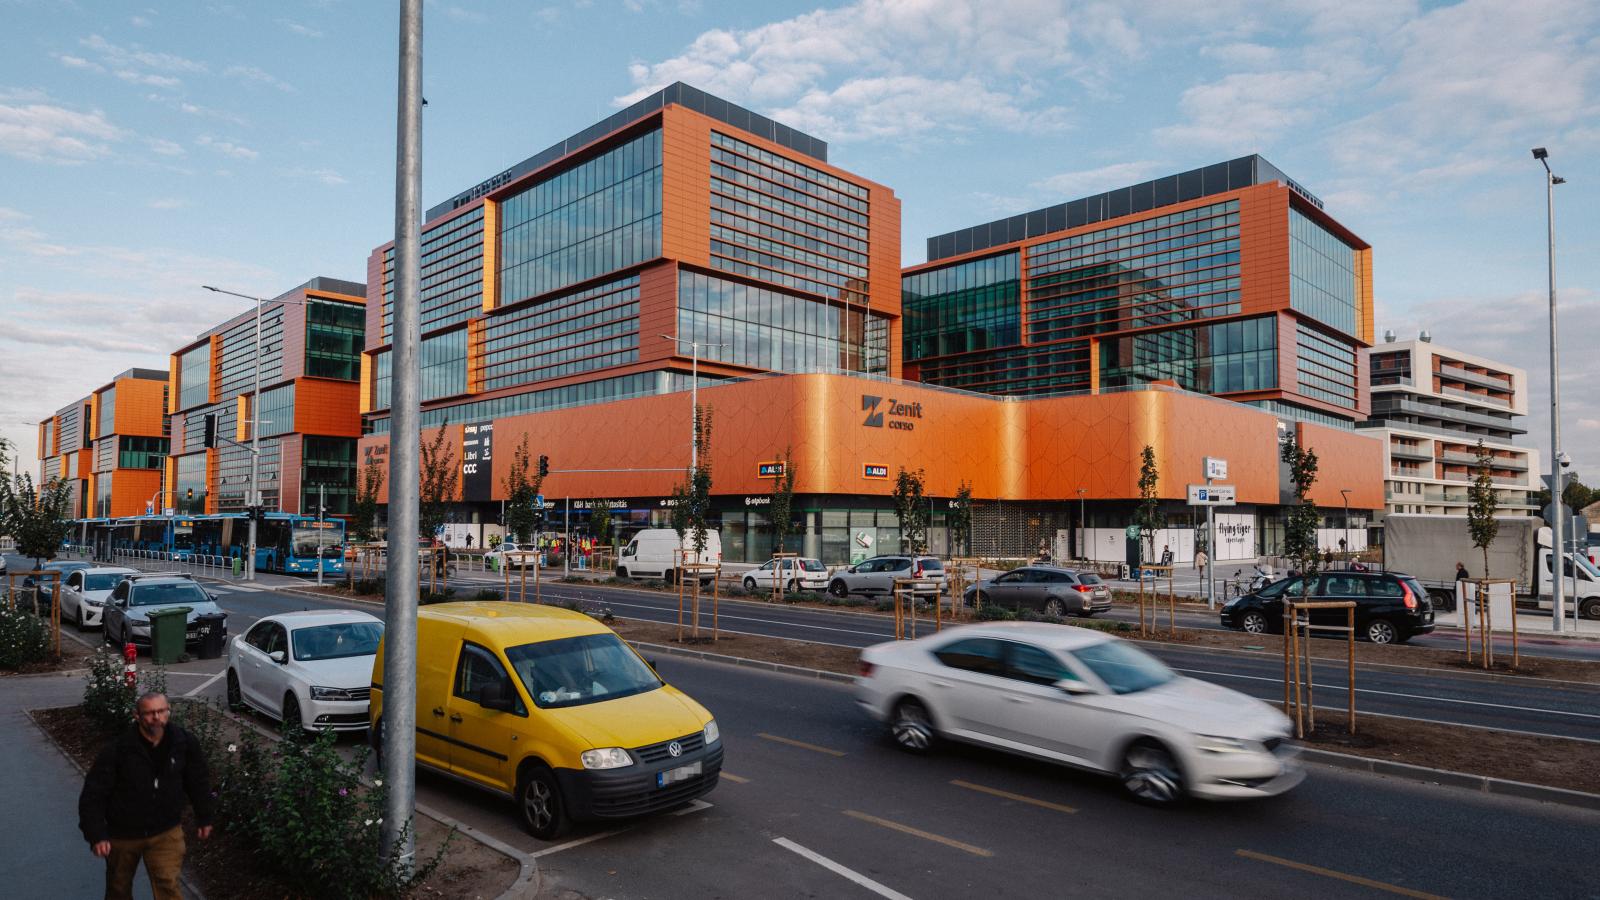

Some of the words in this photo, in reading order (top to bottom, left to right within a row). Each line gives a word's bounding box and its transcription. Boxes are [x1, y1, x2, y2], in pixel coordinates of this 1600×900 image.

[888, 399, 922, 418] Zenit
[889, 421, 914, 430] corso
[464, 451, 477, 460] Libri
[463, 464, 477, 474] CCC
[872, 467, 886, 475] ALDI
[1219, 522, 1236, 536] flying
